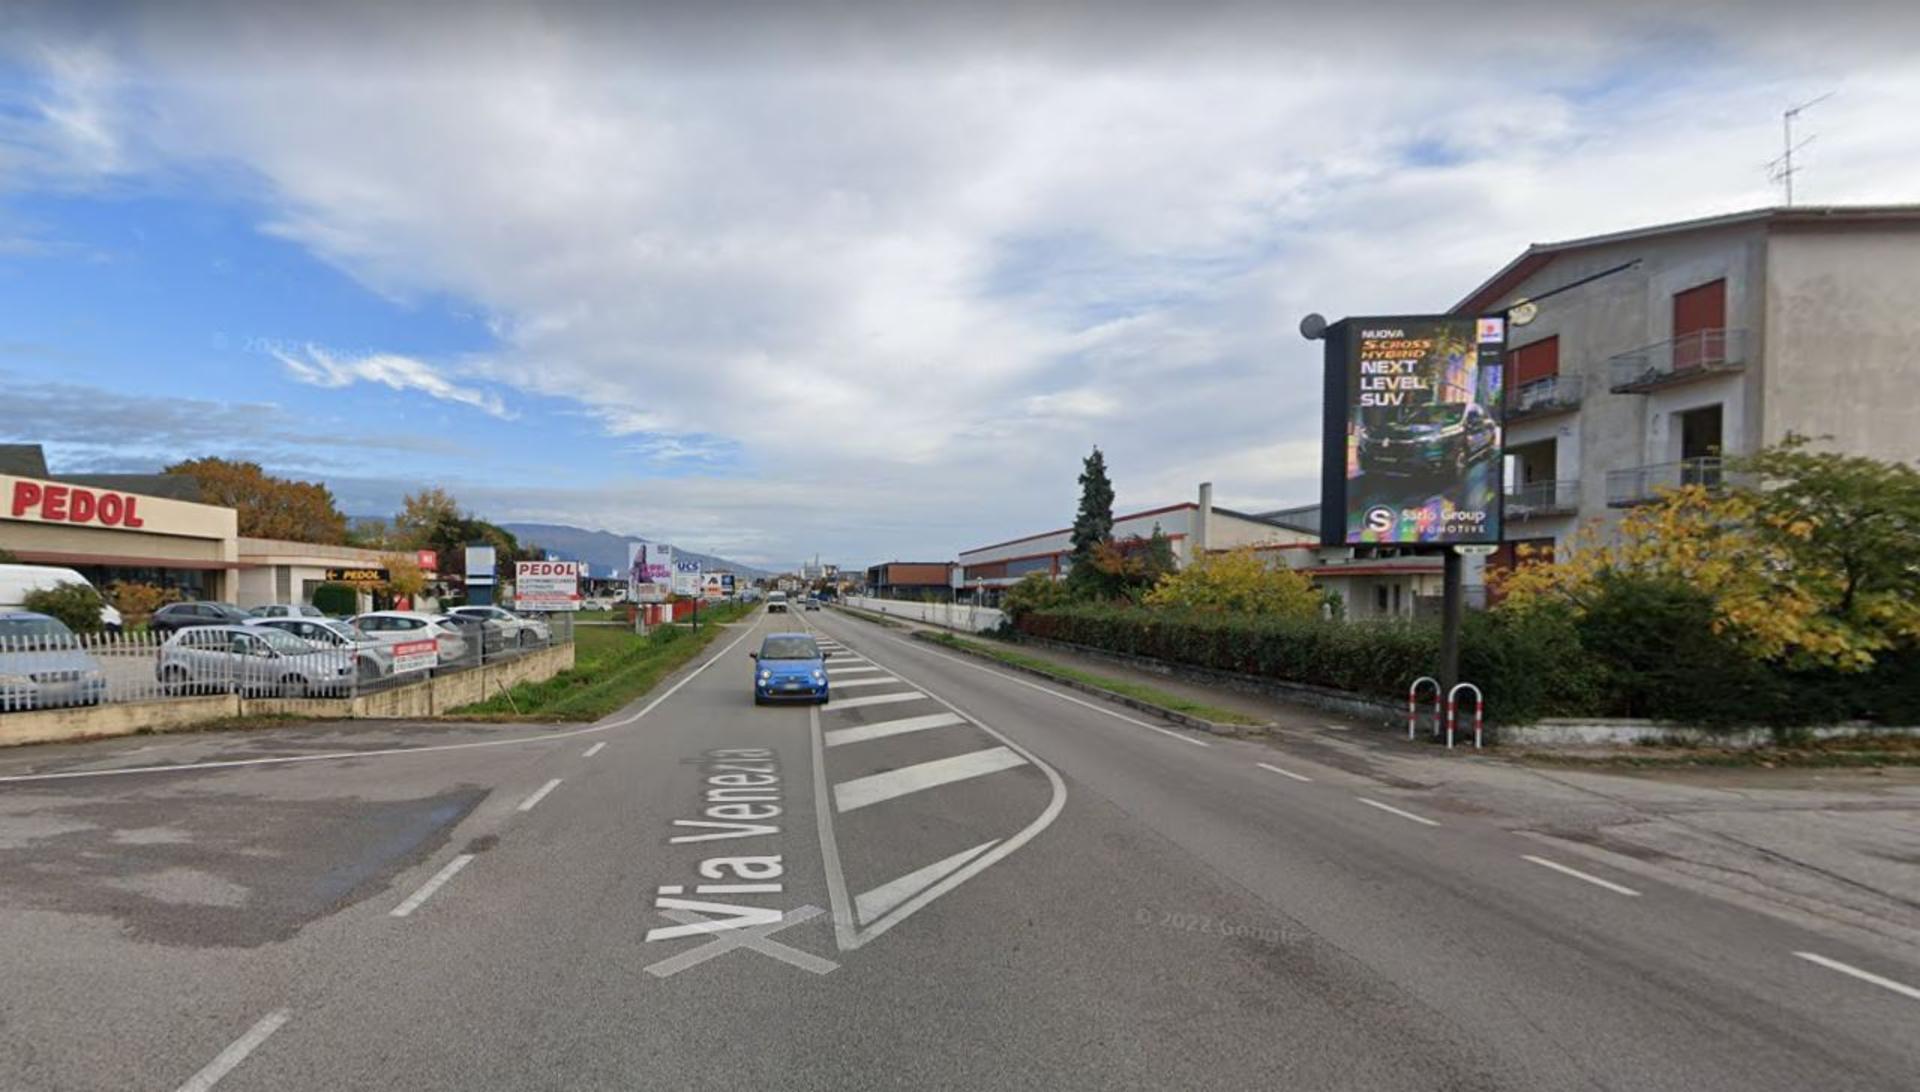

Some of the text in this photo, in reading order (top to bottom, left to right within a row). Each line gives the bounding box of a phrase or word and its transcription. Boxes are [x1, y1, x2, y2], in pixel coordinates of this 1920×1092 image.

[1361, 329, 1404, 338] NUOVA
[1361, 360, 1418, 374] NEXT
[1361, 376, 1428, 390] LEVEL
[1361, 392, 1404, 406] SUV
[12, 481, 144, 528] PEDOL
[1440, 509, 1487, 524] Group
[343, 570, 380, 580] PEDOL
[519, 563, 575, 576] PEDOL
